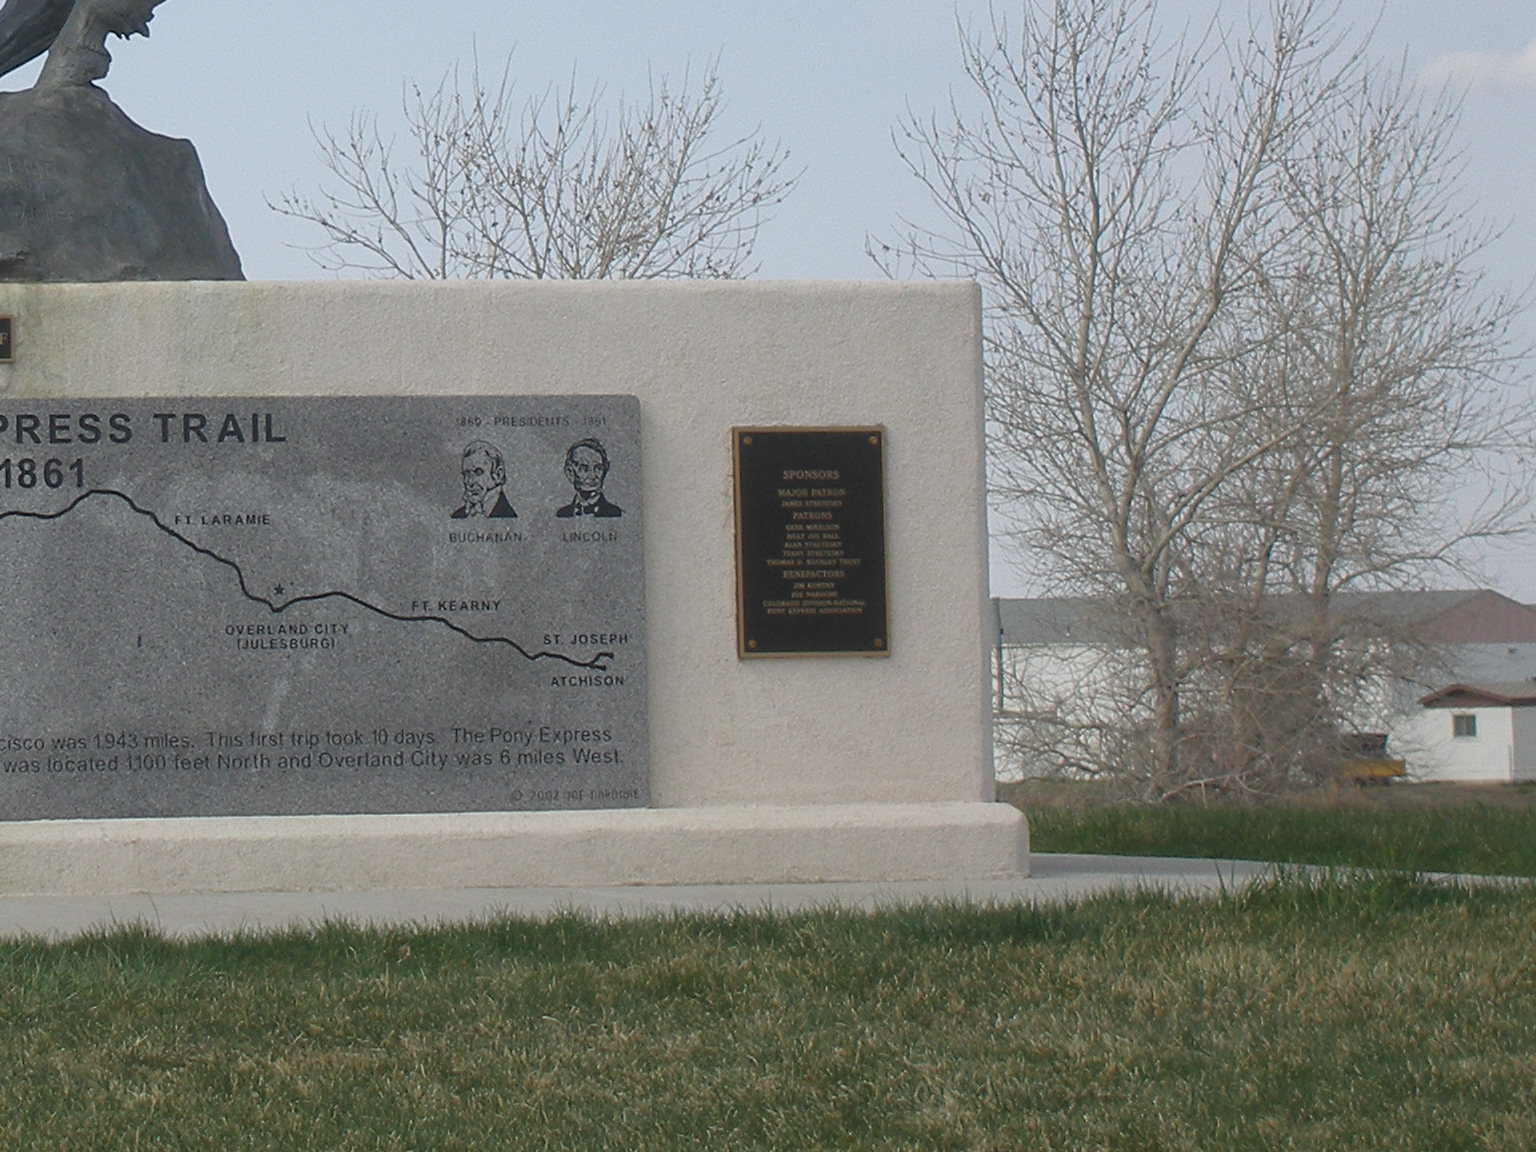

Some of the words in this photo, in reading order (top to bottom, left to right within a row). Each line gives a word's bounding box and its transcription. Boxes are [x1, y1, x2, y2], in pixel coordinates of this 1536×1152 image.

[494, 416, 570, 427] PRESIDENTS
[153, 412, 286, 443] TRAIL
[783, 470, 840, 480] SPONSORS
[777, 488, 808, 497] MAJOR
[811, 488, 846, 496] PATRON
[201, 514, 271, 525] LARAMIE
[792, 512, 832, 520] PATRONS
[449, 532, 523, 543] BUCHANAN
[562, 531, 618, 542] LINCOLN
[783, 570, 845, 579] BENEFACTORS
[438, 600, 502, 611] KEARNY
[225, 624, 308, 636] OVERLAND
[313, 623, 349, 635] CITY
[543, 634, 564, 646] ST.
[570, 634, 628, 645] JOSEPH
[551, 676, 625, 687] ATCHISON
[51, 738, 87, 750] was
[93, 733, 138, 749] 1943
[145, 733, 196, 749] miles.
[207, 731, 239, 748] This
[247, 730, 284, 748] first
[291, 731, 320, 750] trip
[325, 730, 364, 747] took
[372, 728, 389, 745] 10
[452, 728, 484, 745] The
[490, 727, 533, 747] Pony
[539, 726, 613, 746] Express
[3, 760, 41, 774] was
[48, 756, 118, 773] located
[174, 753, 210, 770] feet
[218, 753, 271, 769] North
[278, 752, 311, 769] and
[318, 750, 404, 769] Overland
[411, 749, 449, 770] City
[455, 752, 493, 766] was
[500, 749, 511, 765] 6
[517, 748, 565, 765] miles
